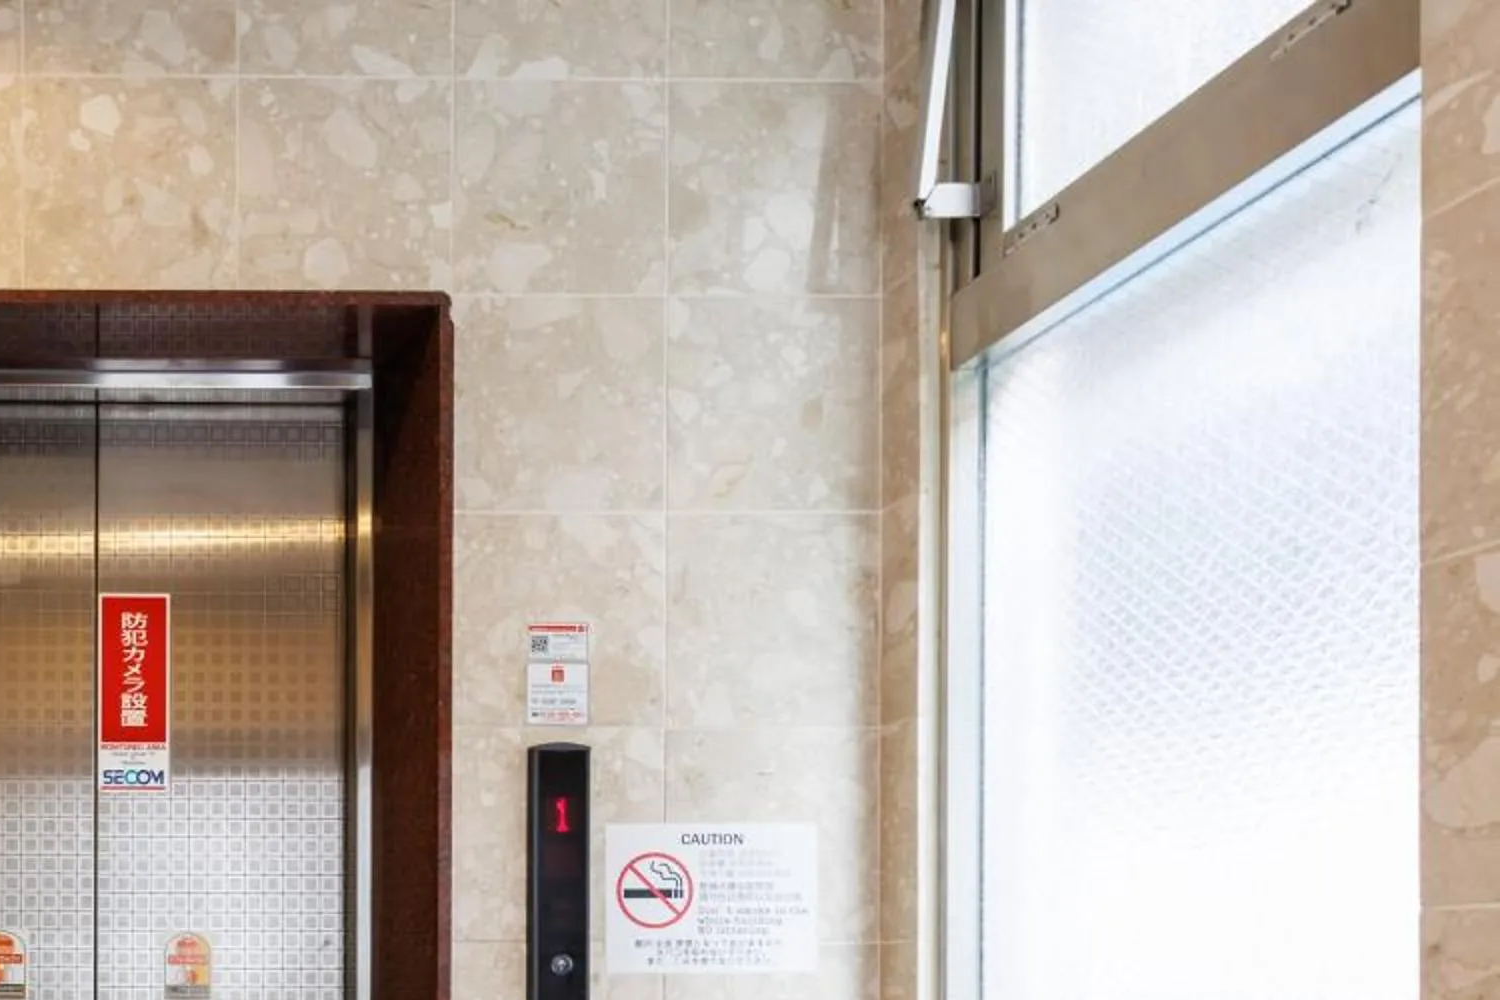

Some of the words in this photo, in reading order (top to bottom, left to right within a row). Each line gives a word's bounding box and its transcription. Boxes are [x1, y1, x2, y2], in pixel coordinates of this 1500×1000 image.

[119, 611, 149, 728] 防犯カメラ設置
[102, 769, 165, 785] SECOM
[555, 796, 570, 834] 1
[680, 832, 744, 846] CAUTION
